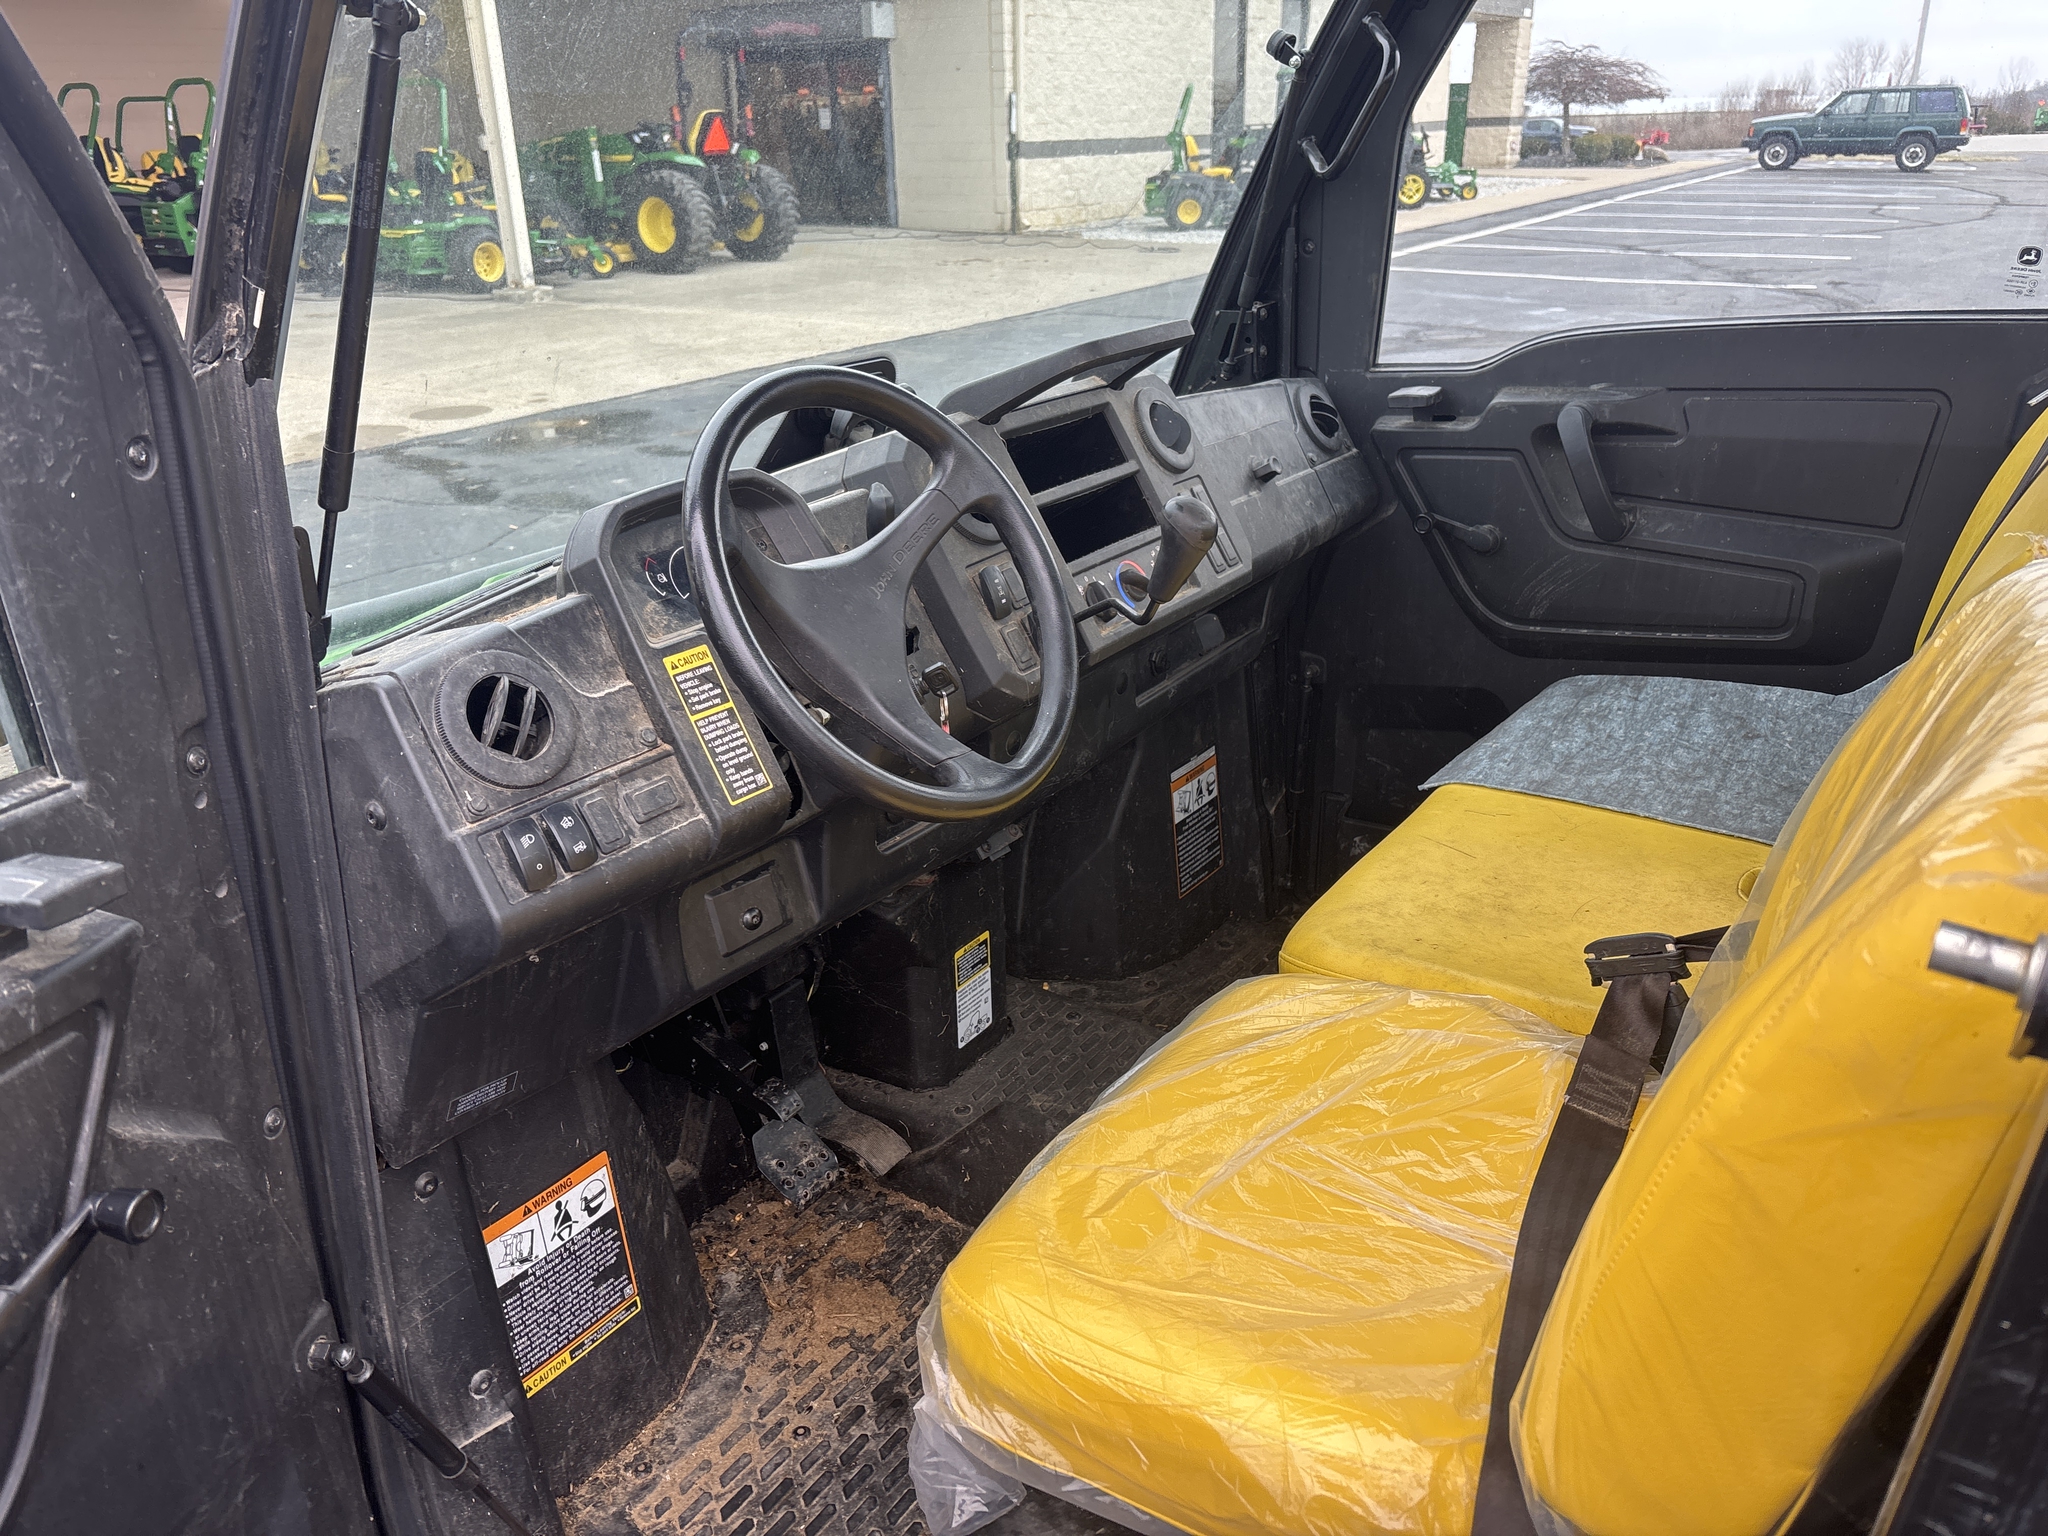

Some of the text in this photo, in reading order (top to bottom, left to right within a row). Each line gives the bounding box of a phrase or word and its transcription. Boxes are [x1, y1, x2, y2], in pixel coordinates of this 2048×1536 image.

[870, 513, 940, 600] JOHN DEERE
[677, 650, 709, 667] CAUTION
[676, 665, 713, 682] BEFORE LEAVING
[687, 682, 714, 696] Stop engine
[699, 692, 710, 700] park
[709, 688, 722, 696] brake
[695, 697, 722, 711] Remove key
[696, 711, 729, 727] HELP PREVENT
[700, 718, 731, 734] INJURY WHEN
[704, 723, 740, 740] DUMPING LOADS
[711, 730, 744, 746] Lock park brake
[714, 737, 748, 753] before dumping
[718, 746, 748, 762] Operate dump
[738, 751, 754, 762] ground
[725, 767, 736, 776] only
[729, 767, 754, 783] Keep hands
[532, 1177, 573, 1210] WARNING
[527, 1258, 545, 1275] Avoid
[546, 1245, 565, 1263] Injury
[574, 1227, 590, 1243] Death
[519, 1274, 534, 1289] from
[535, 1255, 562, 1277] Rollover
[570, 1235, 591, 1254] Falling
[532, 1357, 567, 1389] CAUTION
